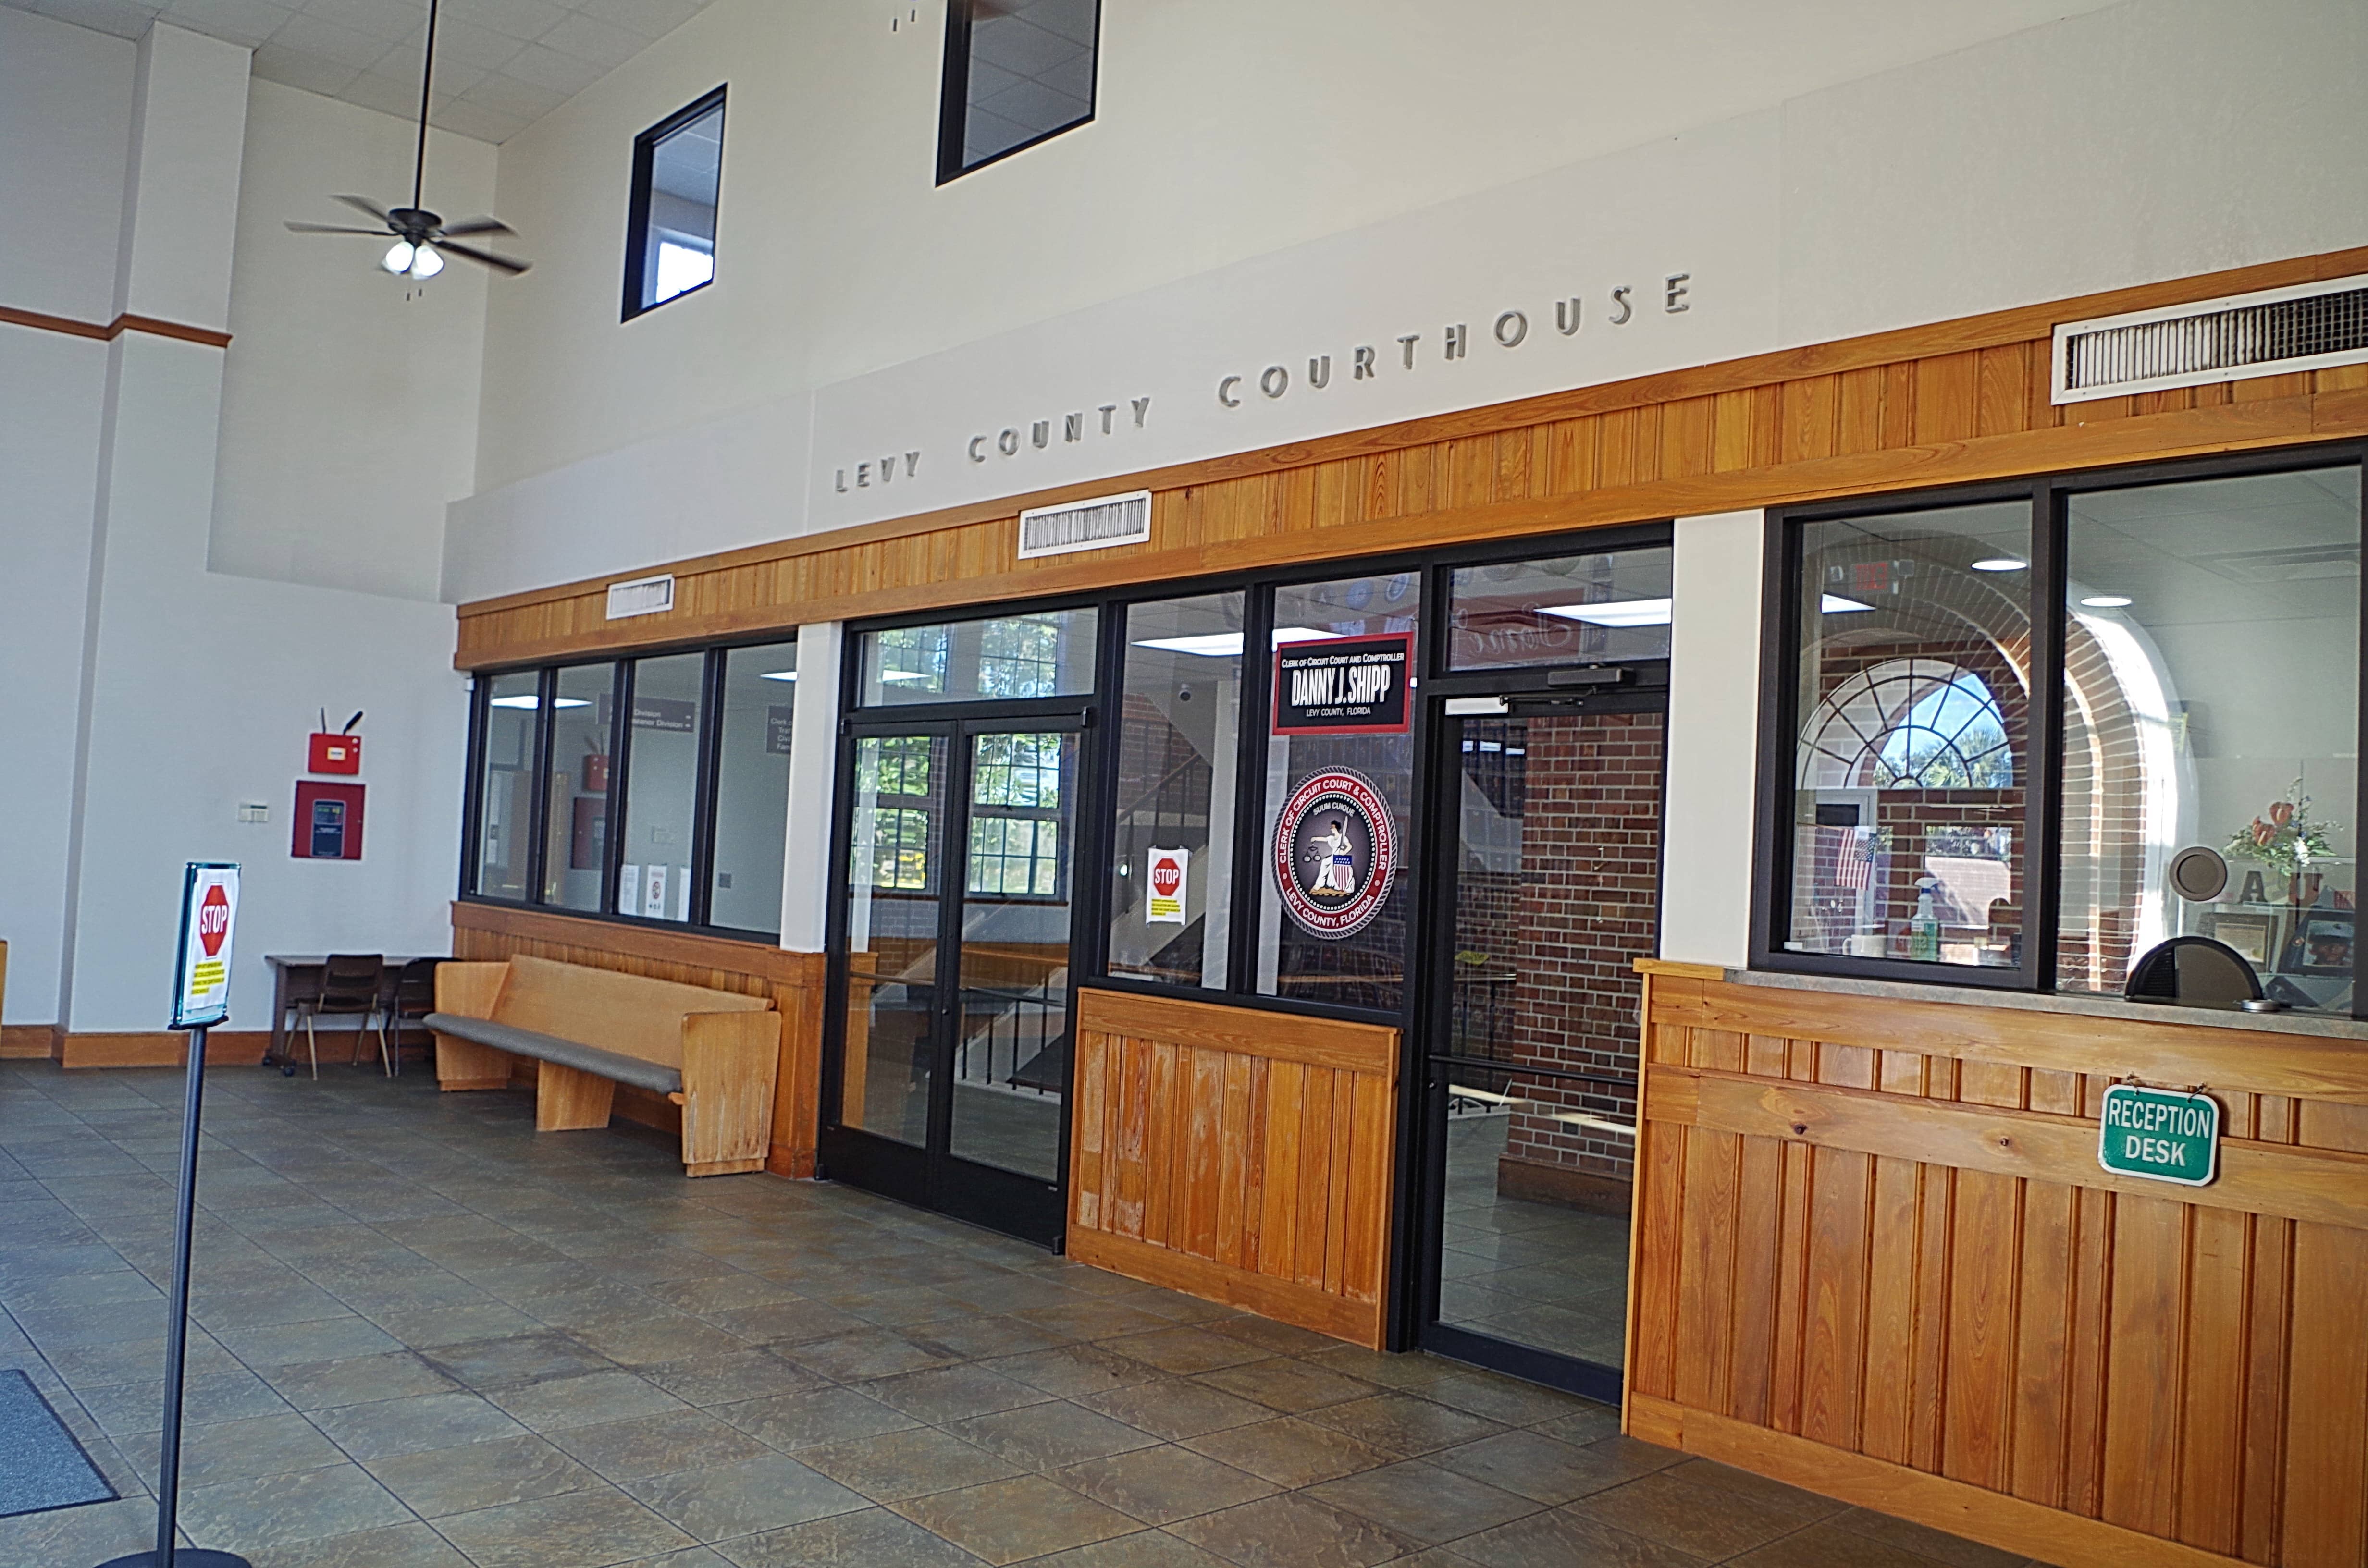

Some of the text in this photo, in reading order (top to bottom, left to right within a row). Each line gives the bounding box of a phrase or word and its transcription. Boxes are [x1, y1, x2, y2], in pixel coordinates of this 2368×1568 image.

[835, 273, 1690, 492] LEVY COUNTY COURTHOUSE
[1291, 668, 1336, 706] DANNY
[1306, 707, 1371, 717] LEVY COUNTY, FLORIDA
[1280, 779, 1388, 870] CLERK OF CIRCUIT COURT & COMPTROLLER
[1313, 802, 1331, 816] SUUM
[1154, 868, 1179, 884] STOP
[200, 904, 227, 934] STOP
[1286, 887, 1375, 927] LEVY COUNTY, FLORIDA
[2108, 1098, 2211, 1139] RECEPTION
[2125, 1135, 2186, 1167] DESK
